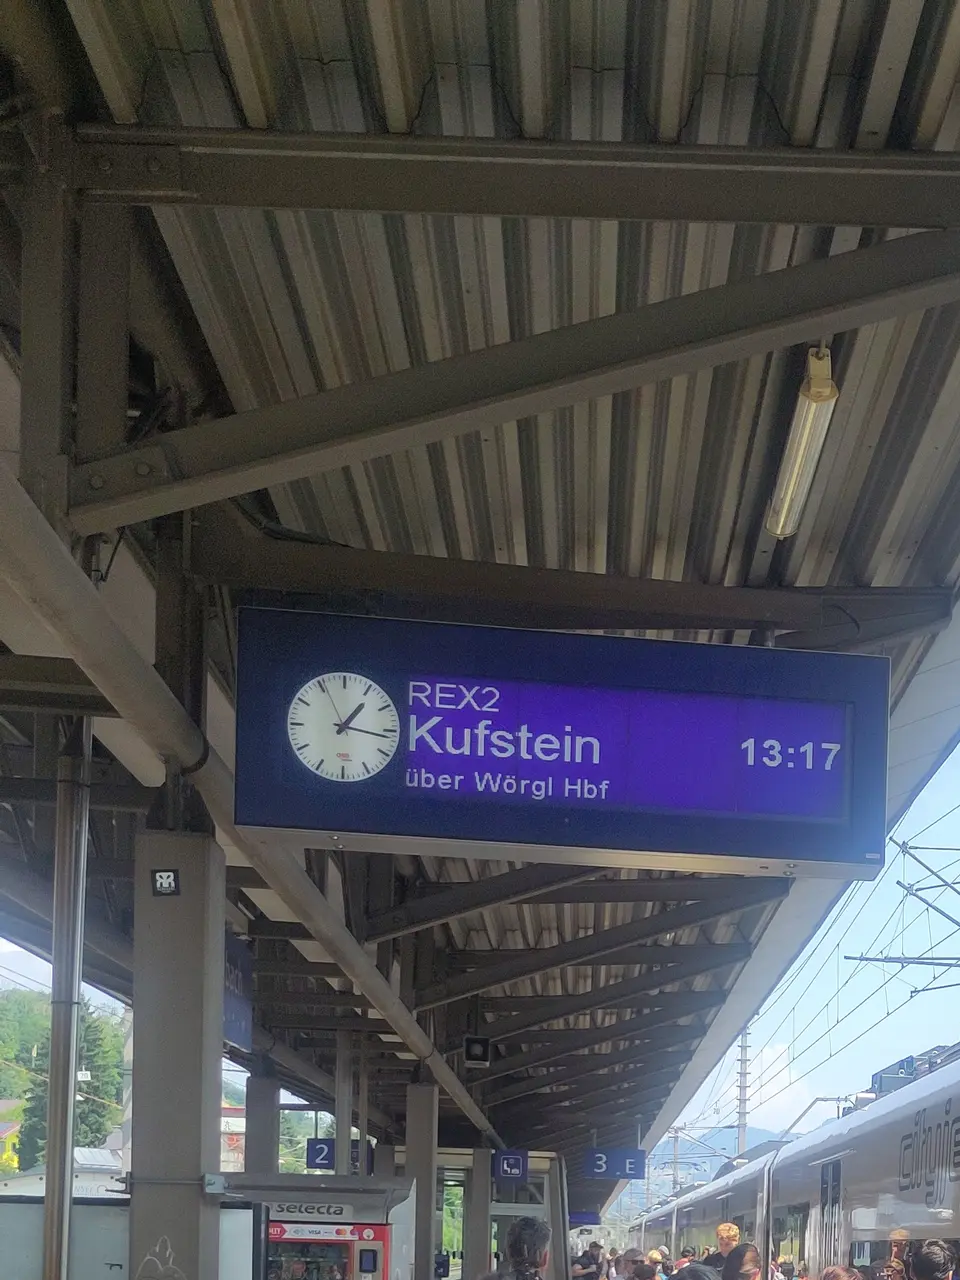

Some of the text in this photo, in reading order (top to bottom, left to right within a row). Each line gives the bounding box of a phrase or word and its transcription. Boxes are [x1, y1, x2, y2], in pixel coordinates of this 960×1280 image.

[408, 681, 500, 713] REX2
[409, 714, 600, 764] Kufstein
[741, 738, 841, 771] 13:17
[405, 767, 610, 800] über Wörgl Hbf
[315, 1144, 329, 1164] 2
[593, 1153, 636, 1174] 3 E
[275, 1202, 344, 1216] selecta
